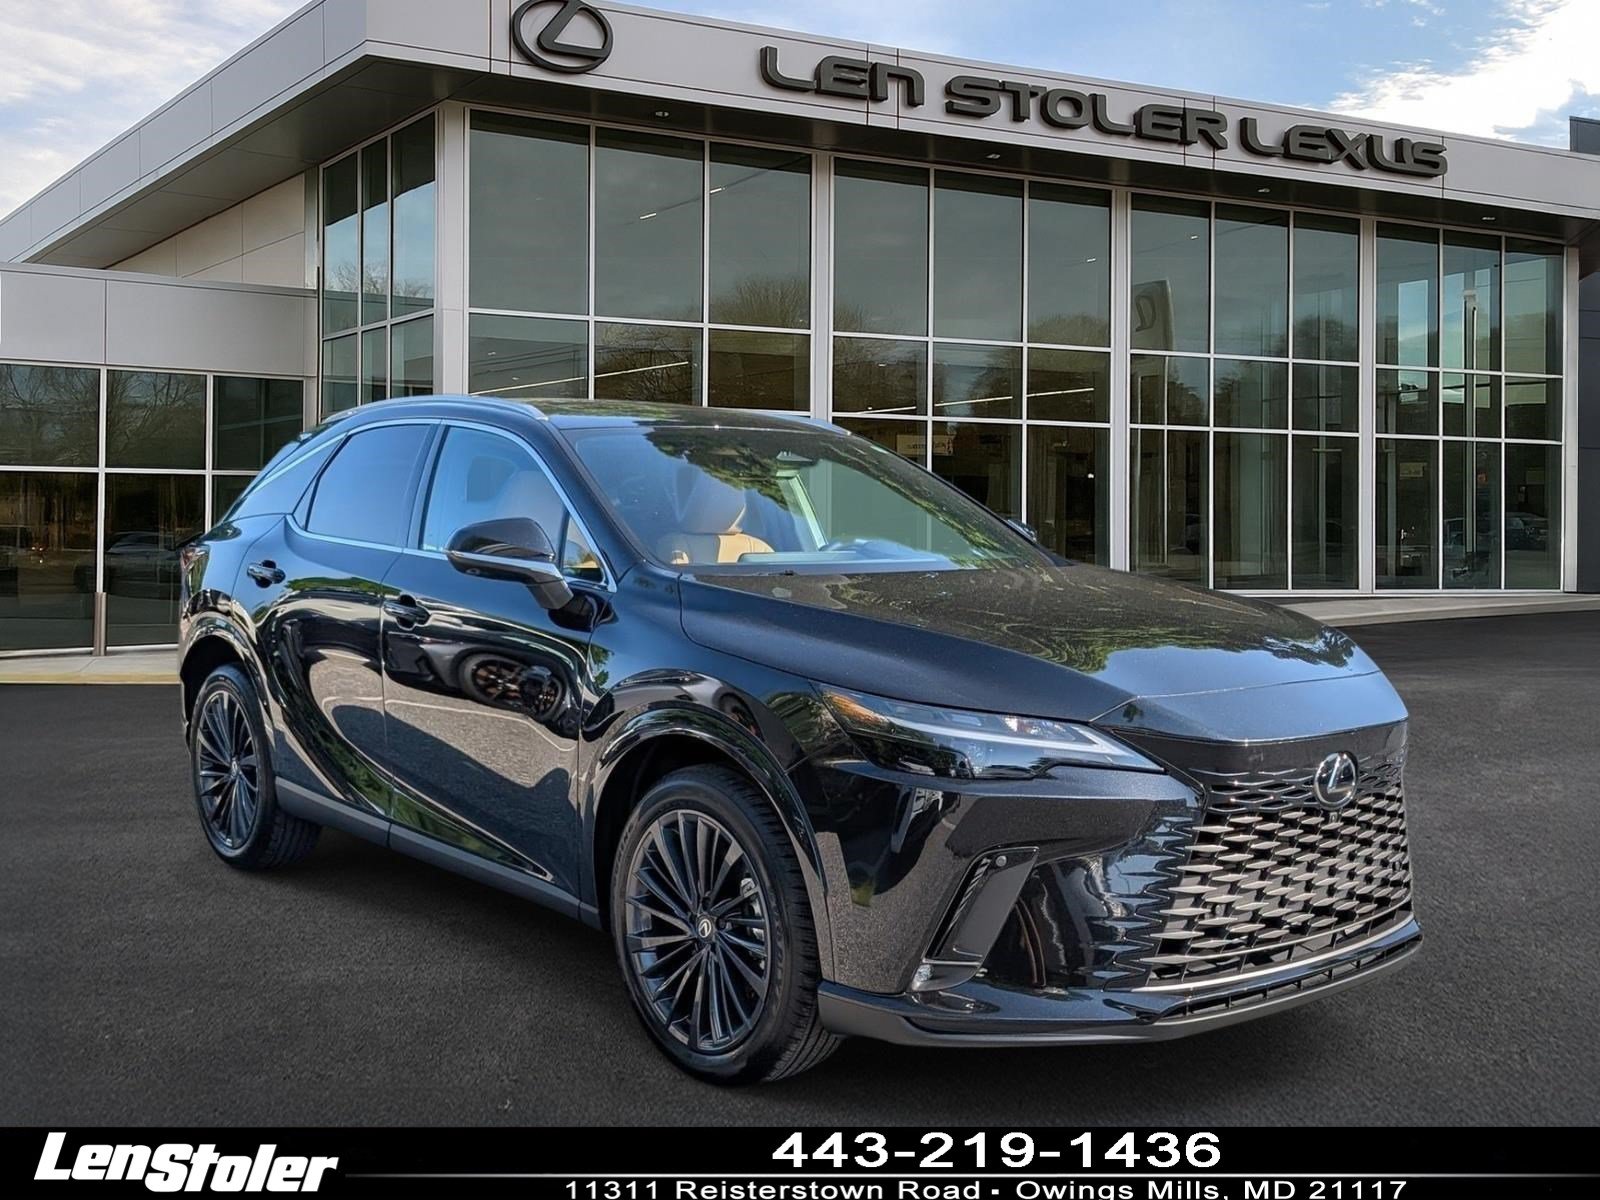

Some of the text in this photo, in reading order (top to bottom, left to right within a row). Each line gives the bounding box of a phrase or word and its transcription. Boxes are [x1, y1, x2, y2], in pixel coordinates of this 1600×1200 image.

[760, 45, 1448, 178] LEN STOLER LEXUS
